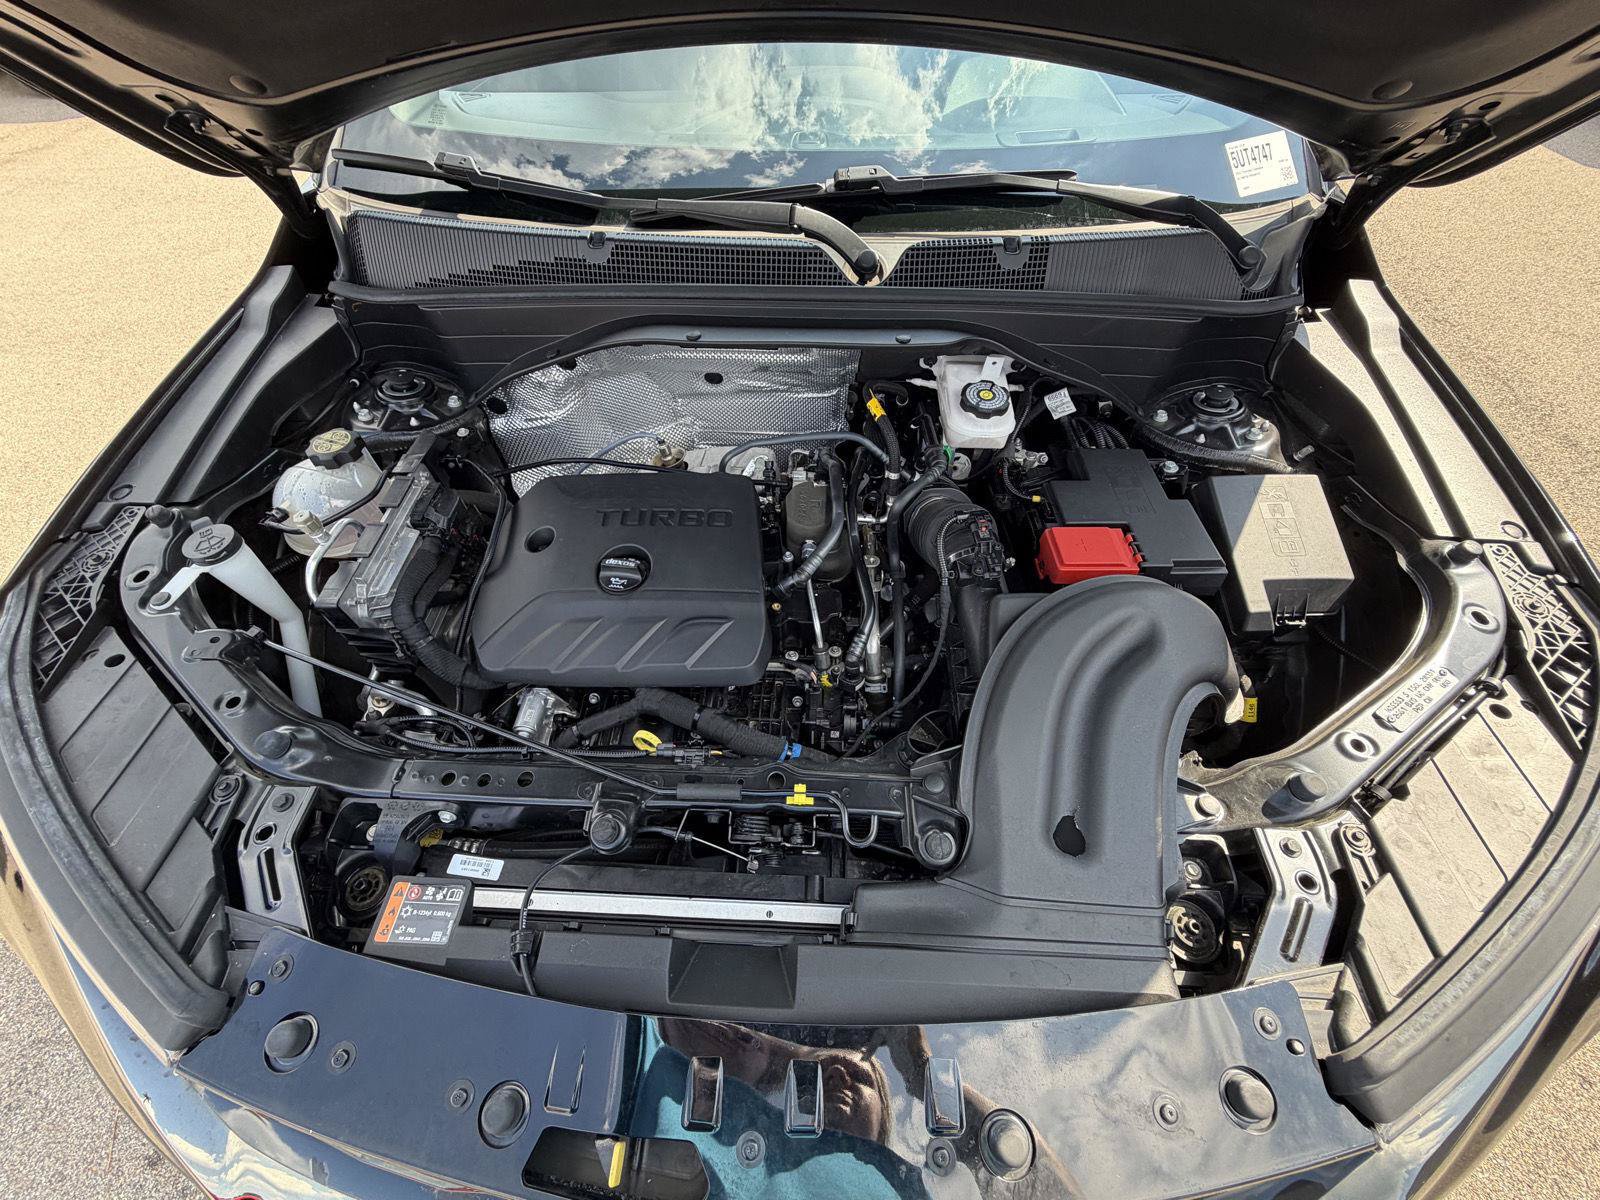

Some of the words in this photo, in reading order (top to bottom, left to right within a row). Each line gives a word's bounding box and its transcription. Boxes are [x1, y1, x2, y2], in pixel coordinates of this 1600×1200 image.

[1230, 143, 1273, 168] 5UT4747
[596, 508, 733, 527] TURBO
[605, 558, 636, 567] dexos
